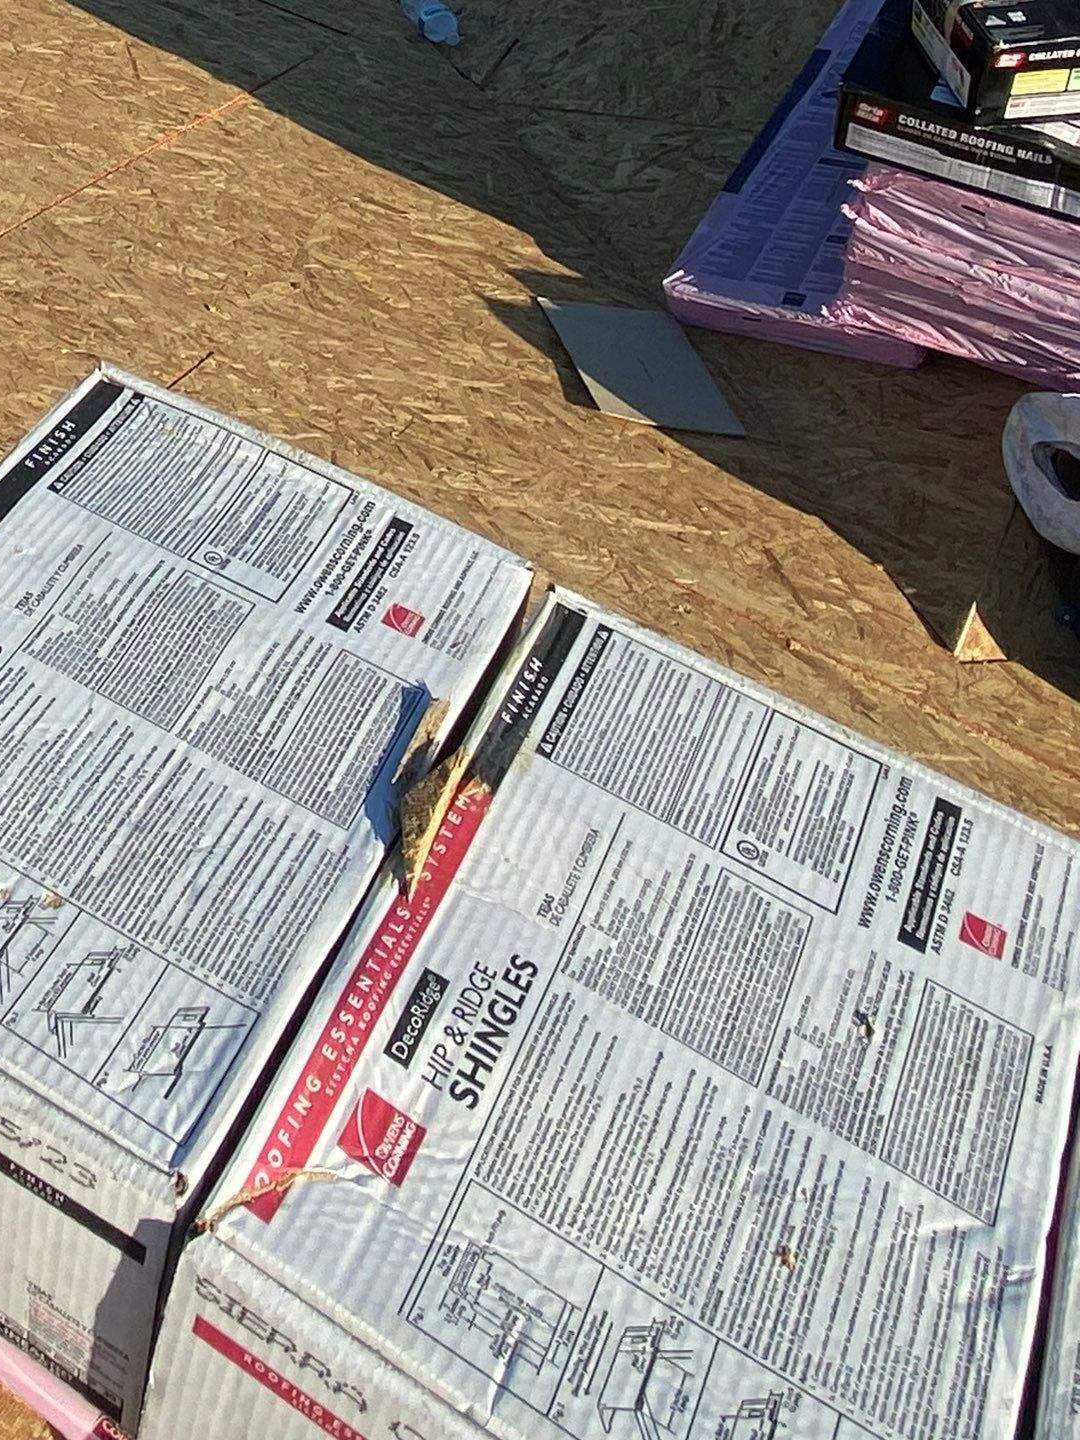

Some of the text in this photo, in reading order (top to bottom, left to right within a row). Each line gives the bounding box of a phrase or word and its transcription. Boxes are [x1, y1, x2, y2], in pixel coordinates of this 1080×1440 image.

[898, 114, 1053, 164] COLLATED ROOFING NAILS
[24, 420, 76, 468] FINISH
[294, 501, 375, 613] www.owenscorning.com
[353, 610, 372, 634] ASTM
[501, 657, 542, 723] FINISH
[859, 776, 912, 928] www.owenscorning.com
[930, 923, 946, 956] ASTM
[938, 913, 949, 925] D
[950, 846, 966, 877] CSA-A
[250, 1075, 321, 1192] OOFING
[321, 907, 410, 1061] ESSENTIALS
[358, 970, 392, 1030] ROOFING
[421, 961, 497, 1092] HIP & RIDGE
[450, 955, 538, 1109] SHINGLES
[195, 1274, 368, 1413] SIERRA
[242, 1352, 324, 1417] ROOFING
